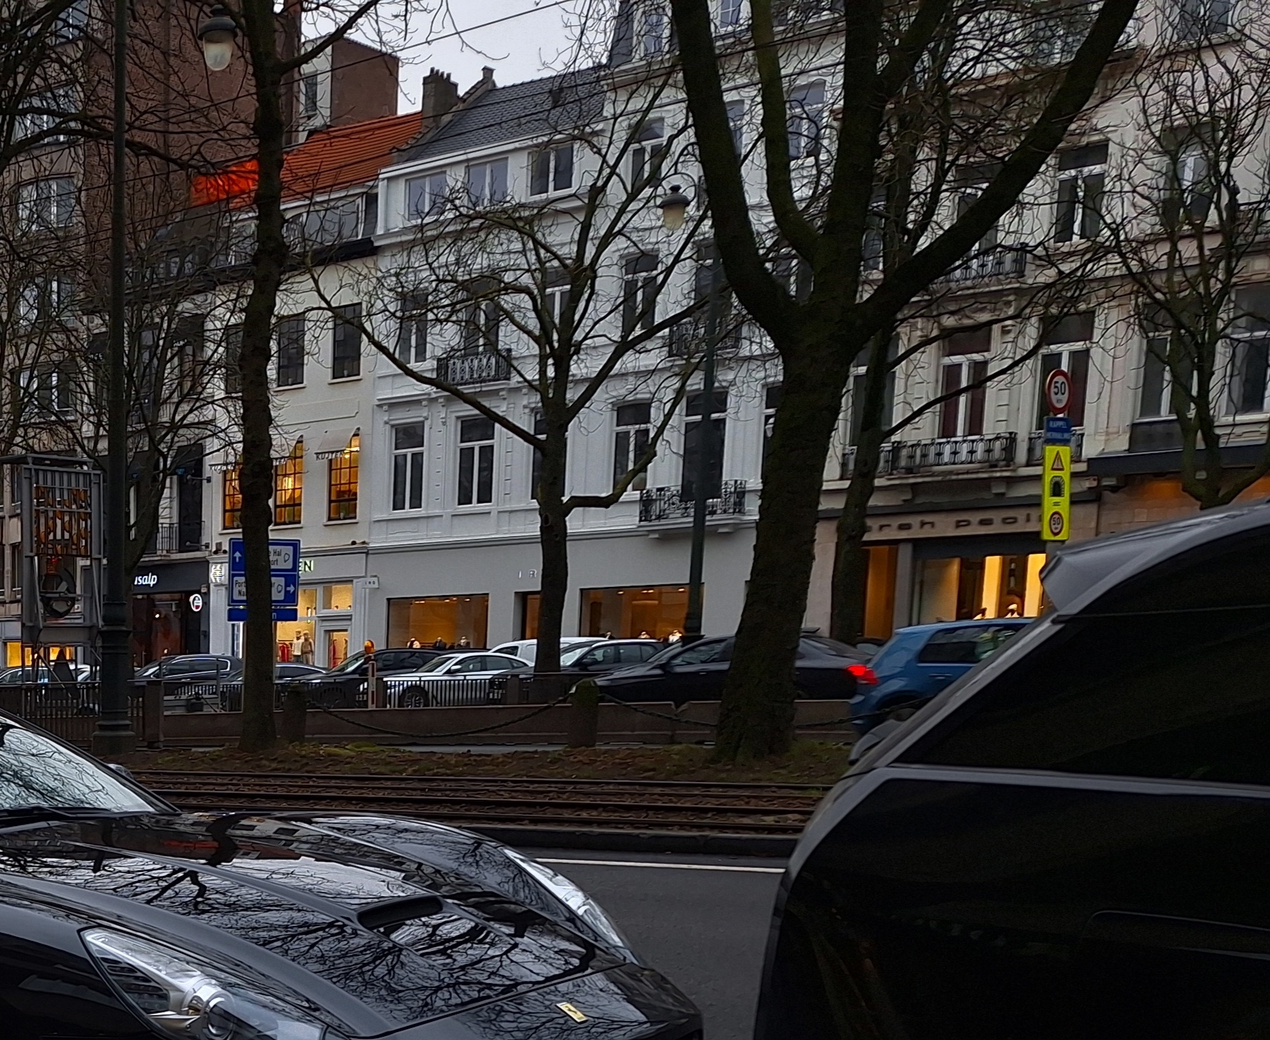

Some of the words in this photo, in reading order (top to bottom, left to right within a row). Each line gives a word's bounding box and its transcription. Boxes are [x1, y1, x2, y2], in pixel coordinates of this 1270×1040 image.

[1053, 381, 1066, 395] 50
[868, 519, 934, 532] rah
[1052, 516, 1060, 526] 50
[299, 559, 313, 573] EN
